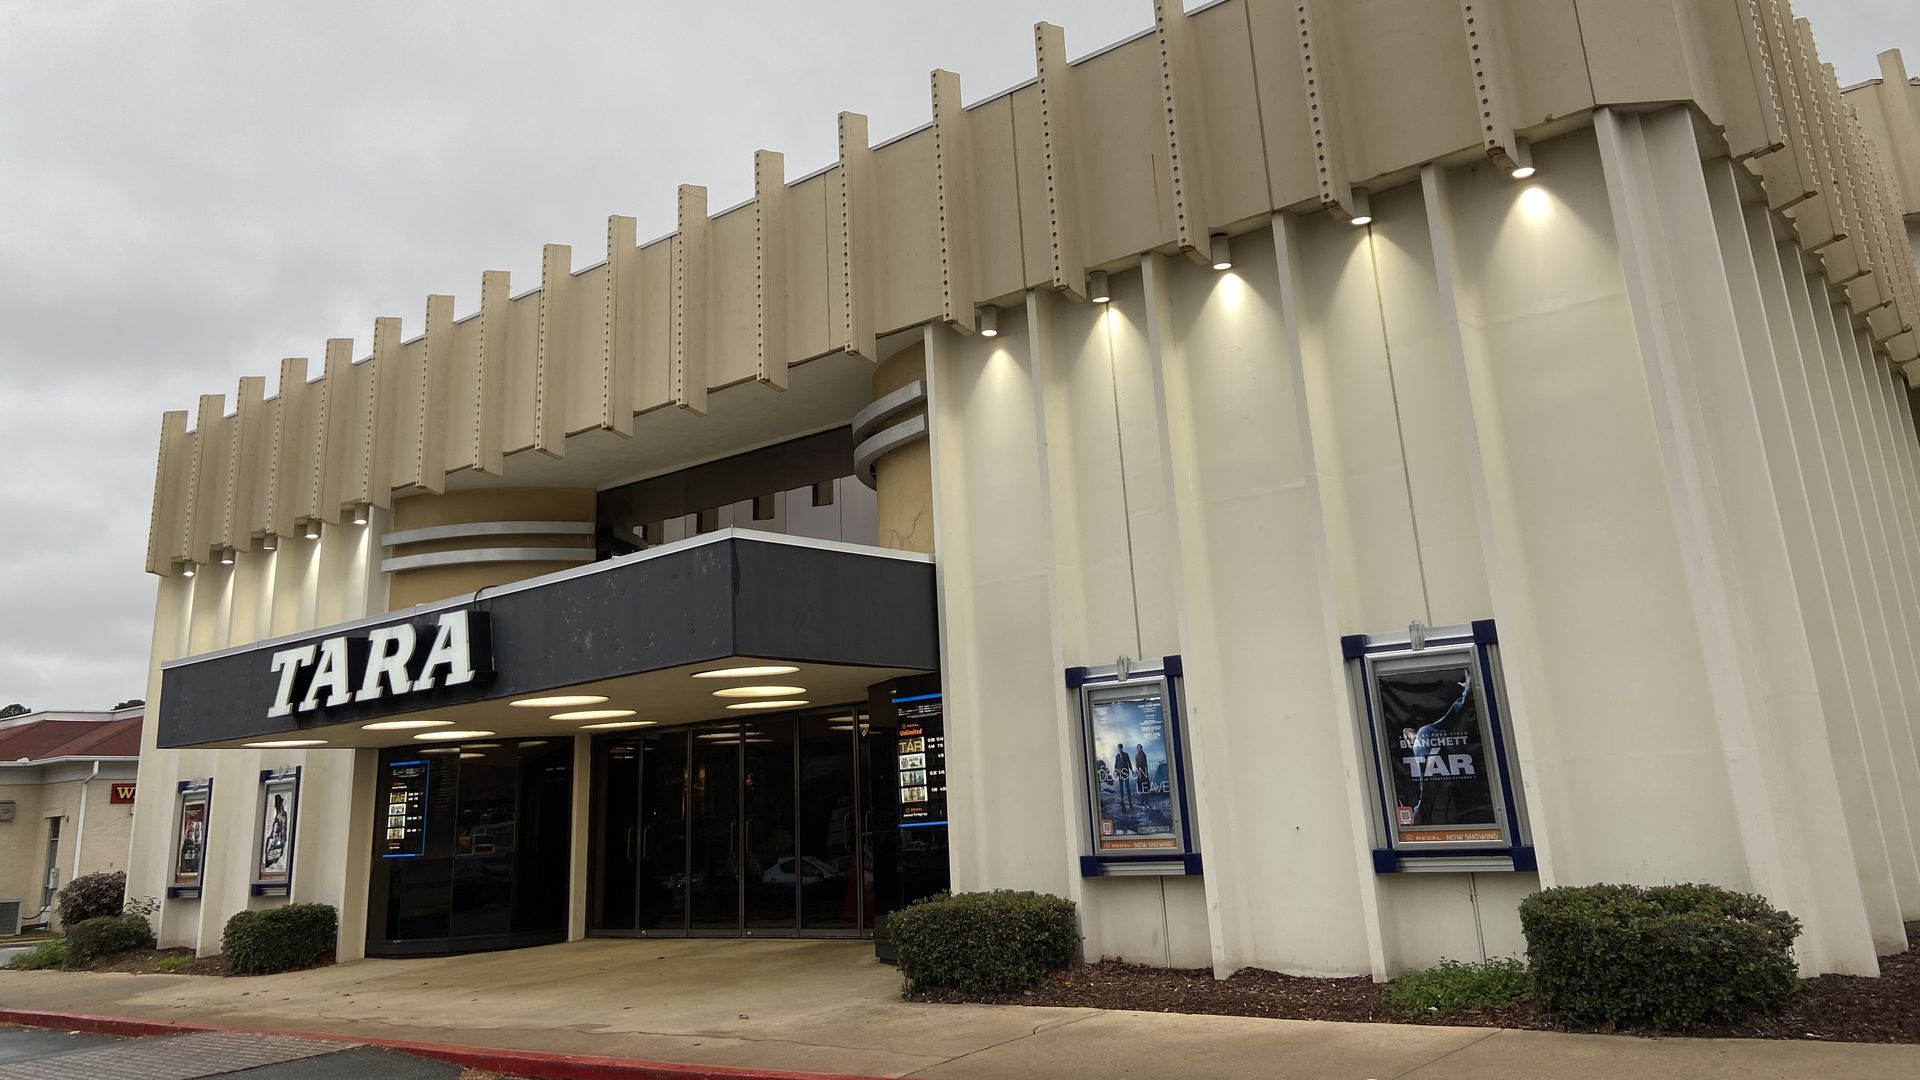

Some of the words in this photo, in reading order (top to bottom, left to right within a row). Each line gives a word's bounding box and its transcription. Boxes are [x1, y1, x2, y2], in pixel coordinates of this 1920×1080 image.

[267, 609, 475, 718] TARA
[1400, 736, 1468, 749] BLANCHETT
[1403, 747, 1475, 777] TÁR
[1136, 780, 1170, 794] LEAVE
[1464, 832, 1498, 841] SHOWING
